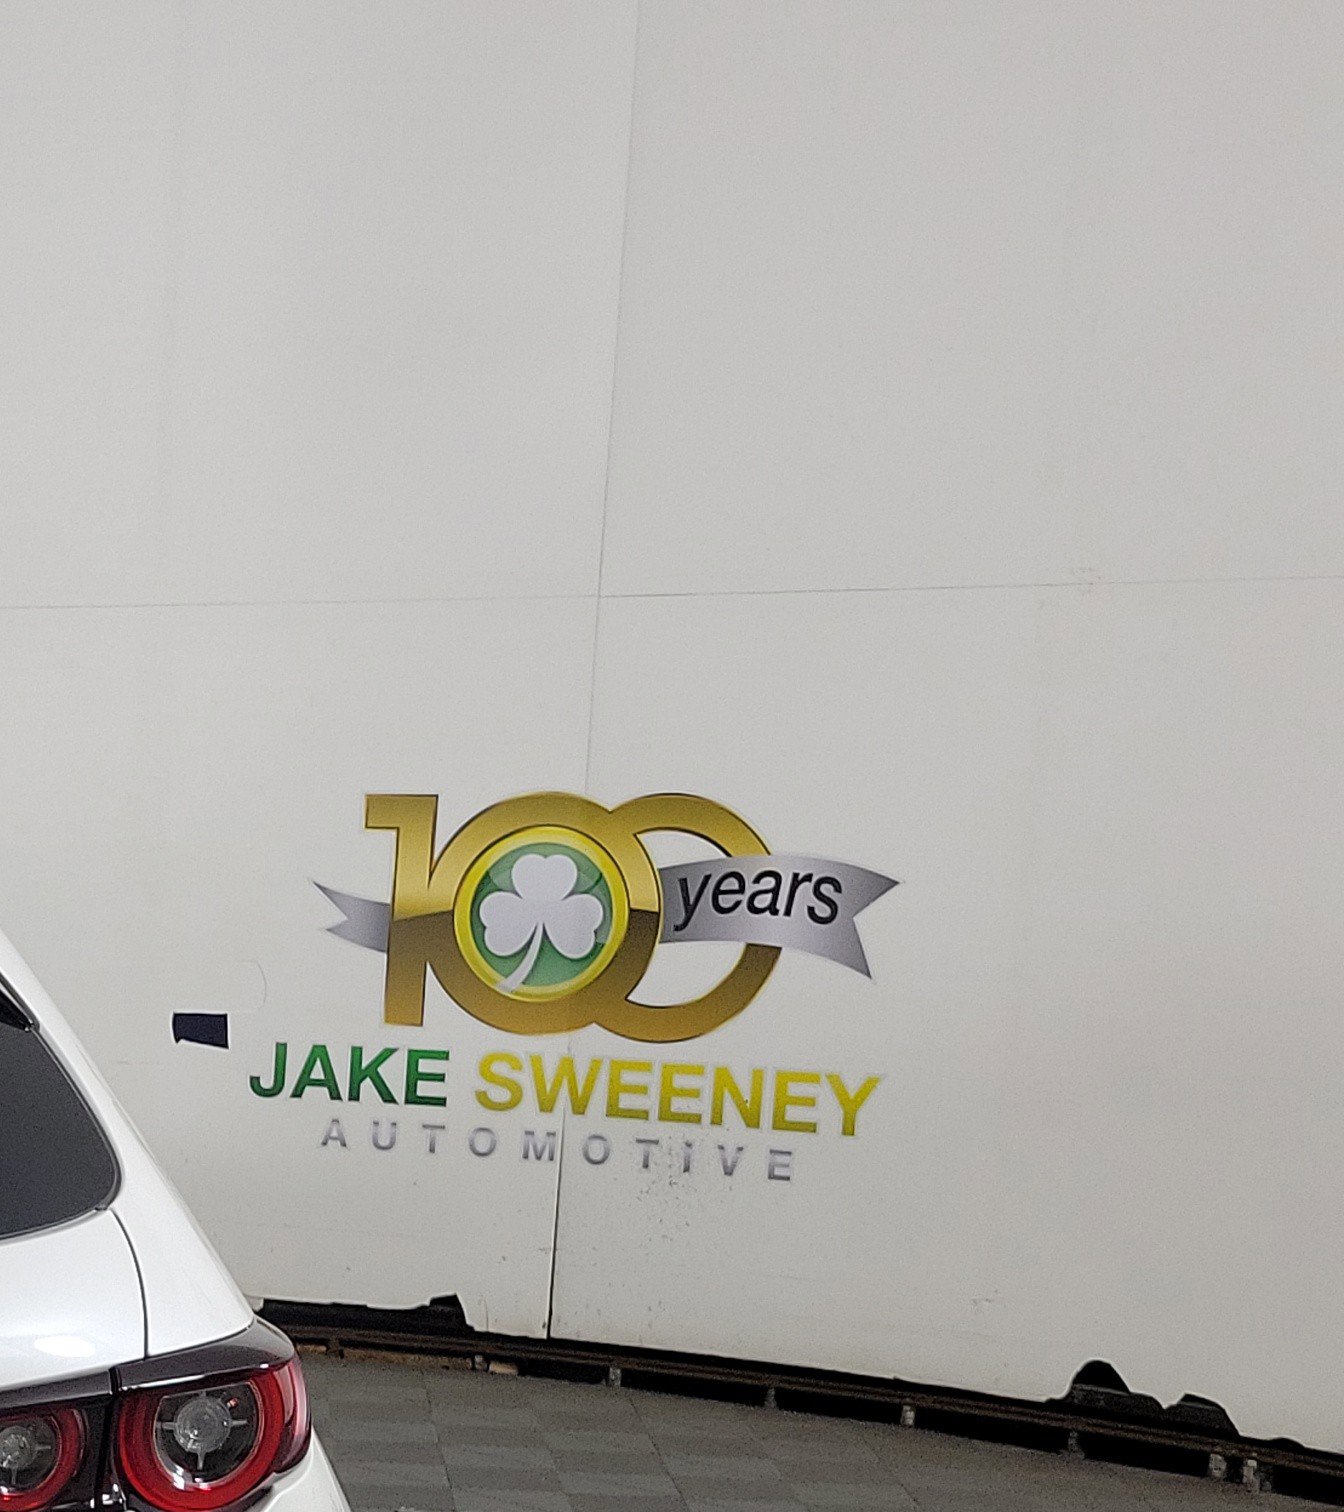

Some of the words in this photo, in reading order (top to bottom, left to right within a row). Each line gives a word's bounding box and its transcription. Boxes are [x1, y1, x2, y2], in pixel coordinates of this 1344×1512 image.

[365, 791, 781, 1042] 100
[673, 868, 843, 932] years
[249, 1041, 450, 1107] JAKE
[474, 1052, 881, 1136] SWEENEY
[320, 1118, 792, 1181] AUTOMOTIVE
